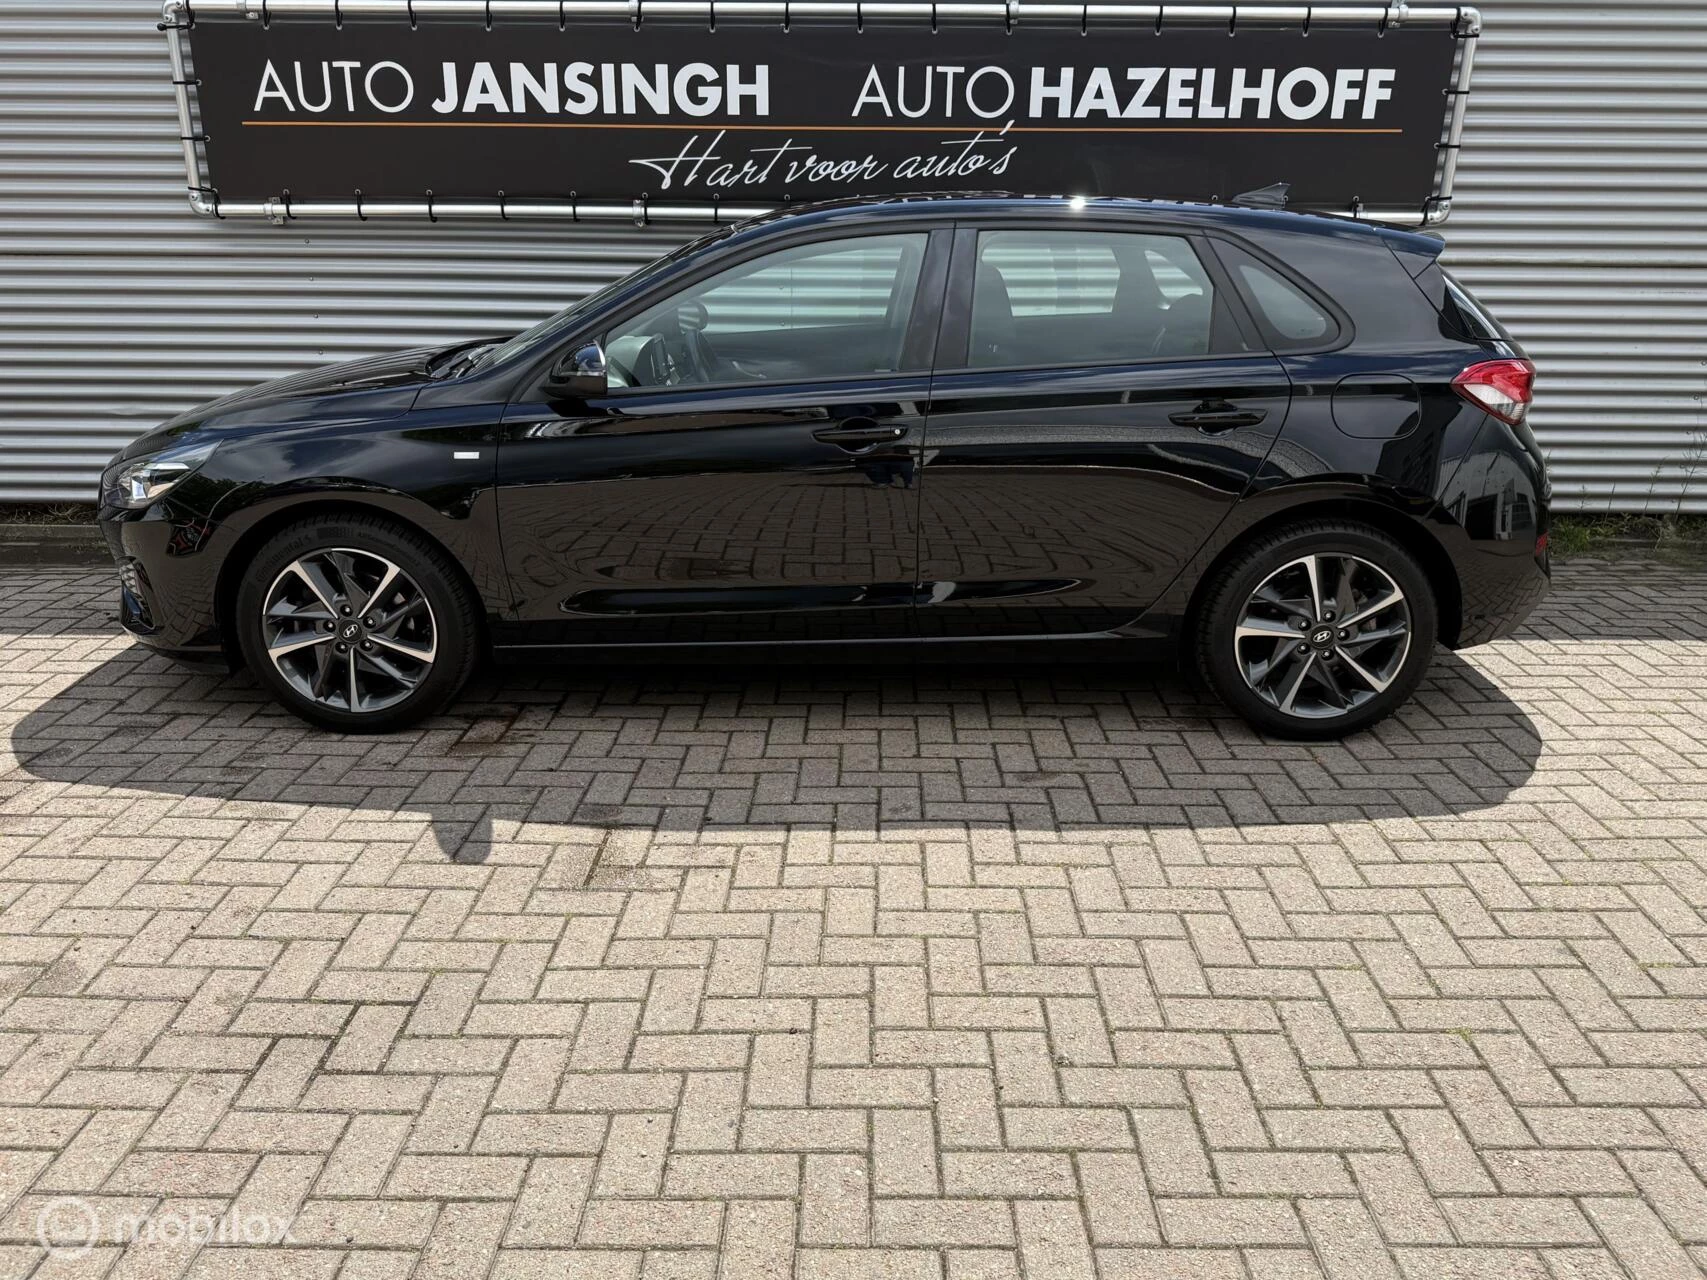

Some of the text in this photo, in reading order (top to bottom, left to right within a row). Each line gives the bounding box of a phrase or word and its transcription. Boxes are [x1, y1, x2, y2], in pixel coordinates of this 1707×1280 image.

[253, 58, 770, 116] AUTO JANSINGH
[851, 63, 1397, 120] AUTO HAZELHOFF
[628, 119, 1018, 190] Hart voor auto's
